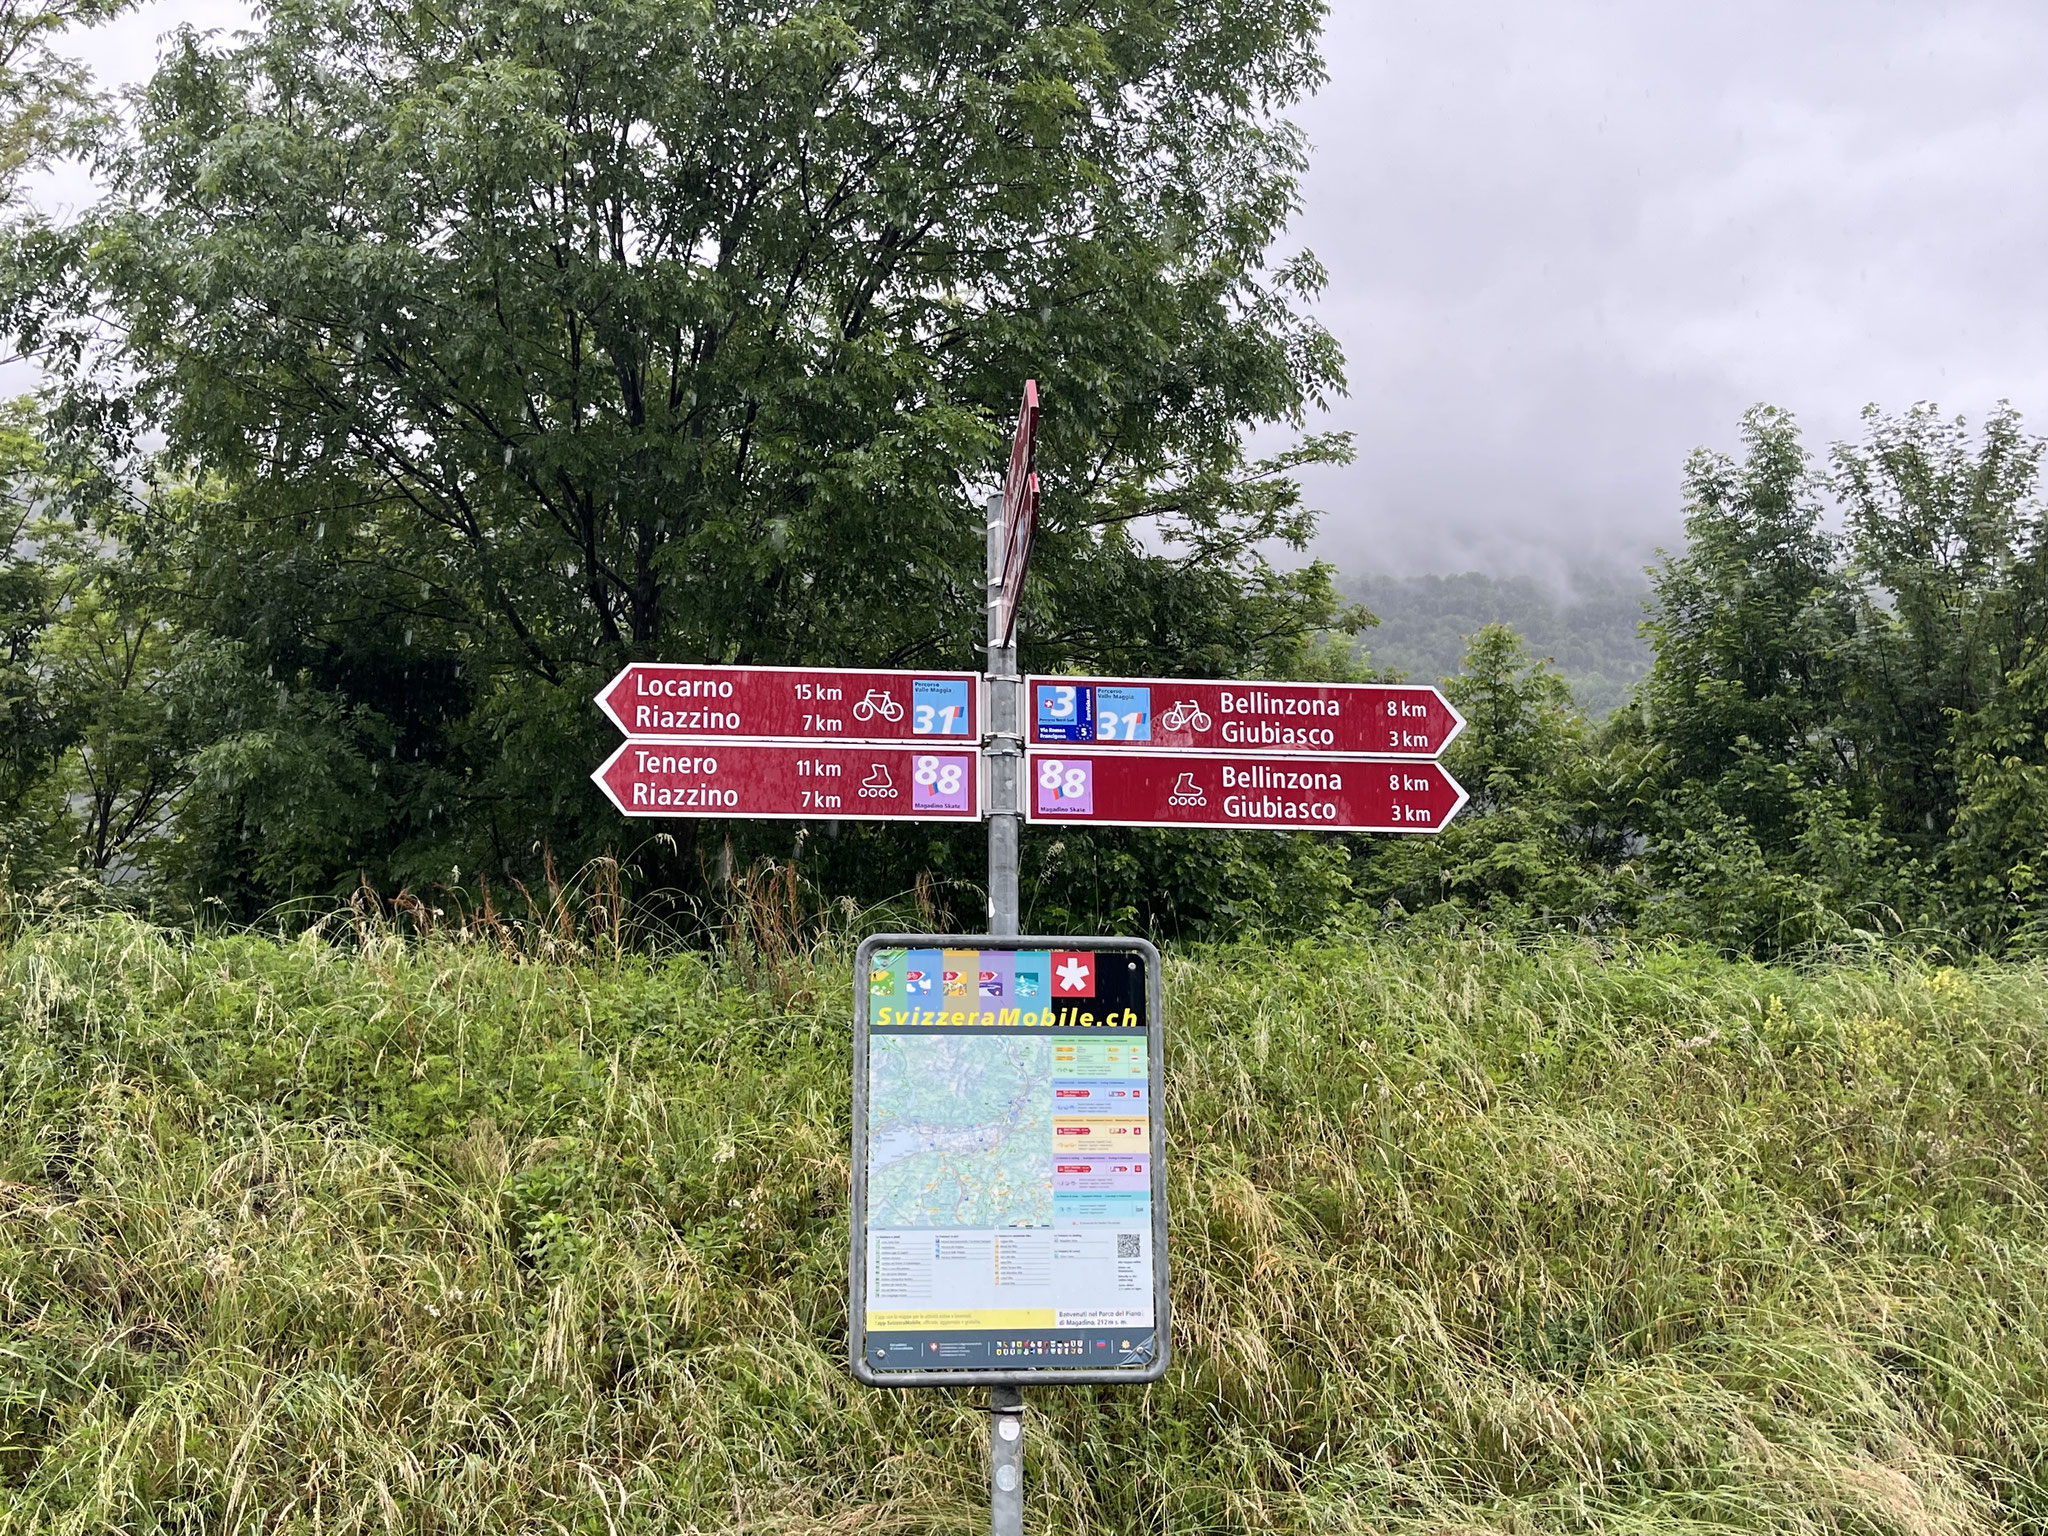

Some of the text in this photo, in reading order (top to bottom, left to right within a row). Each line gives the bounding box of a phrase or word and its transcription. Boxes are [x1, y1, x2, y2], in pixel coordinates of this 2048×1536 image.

[637, 673, 843, 701] Locarno 15 km
[1050, 686, 1075, 717] 3
[1220, 691, 1427, 718] Bellinzona 8 km
[636, 704, 842, 732] Riazzino 7 km
[912, 704, 956, 735] 31
[1081, 727, 1088, 737] 5
[1096, 711, 1138, 741] 31
[1221, 720, 1429, 748] Giubiasco 3 km
[634, 750, 842, 777] Tenero 11 km
[914, 755, 963, 795] 88
[1039, 759, 1087, 799] 88
[1222, 765, 1429, 792] Bellinzona 8 km
[632, 781, 841, 808] Riazzino 7 km
[1223, 794, 1431, 822] Giubiasco 3 km
[877, 1006, 1138, 1027] SvizzeraMobile.ch
